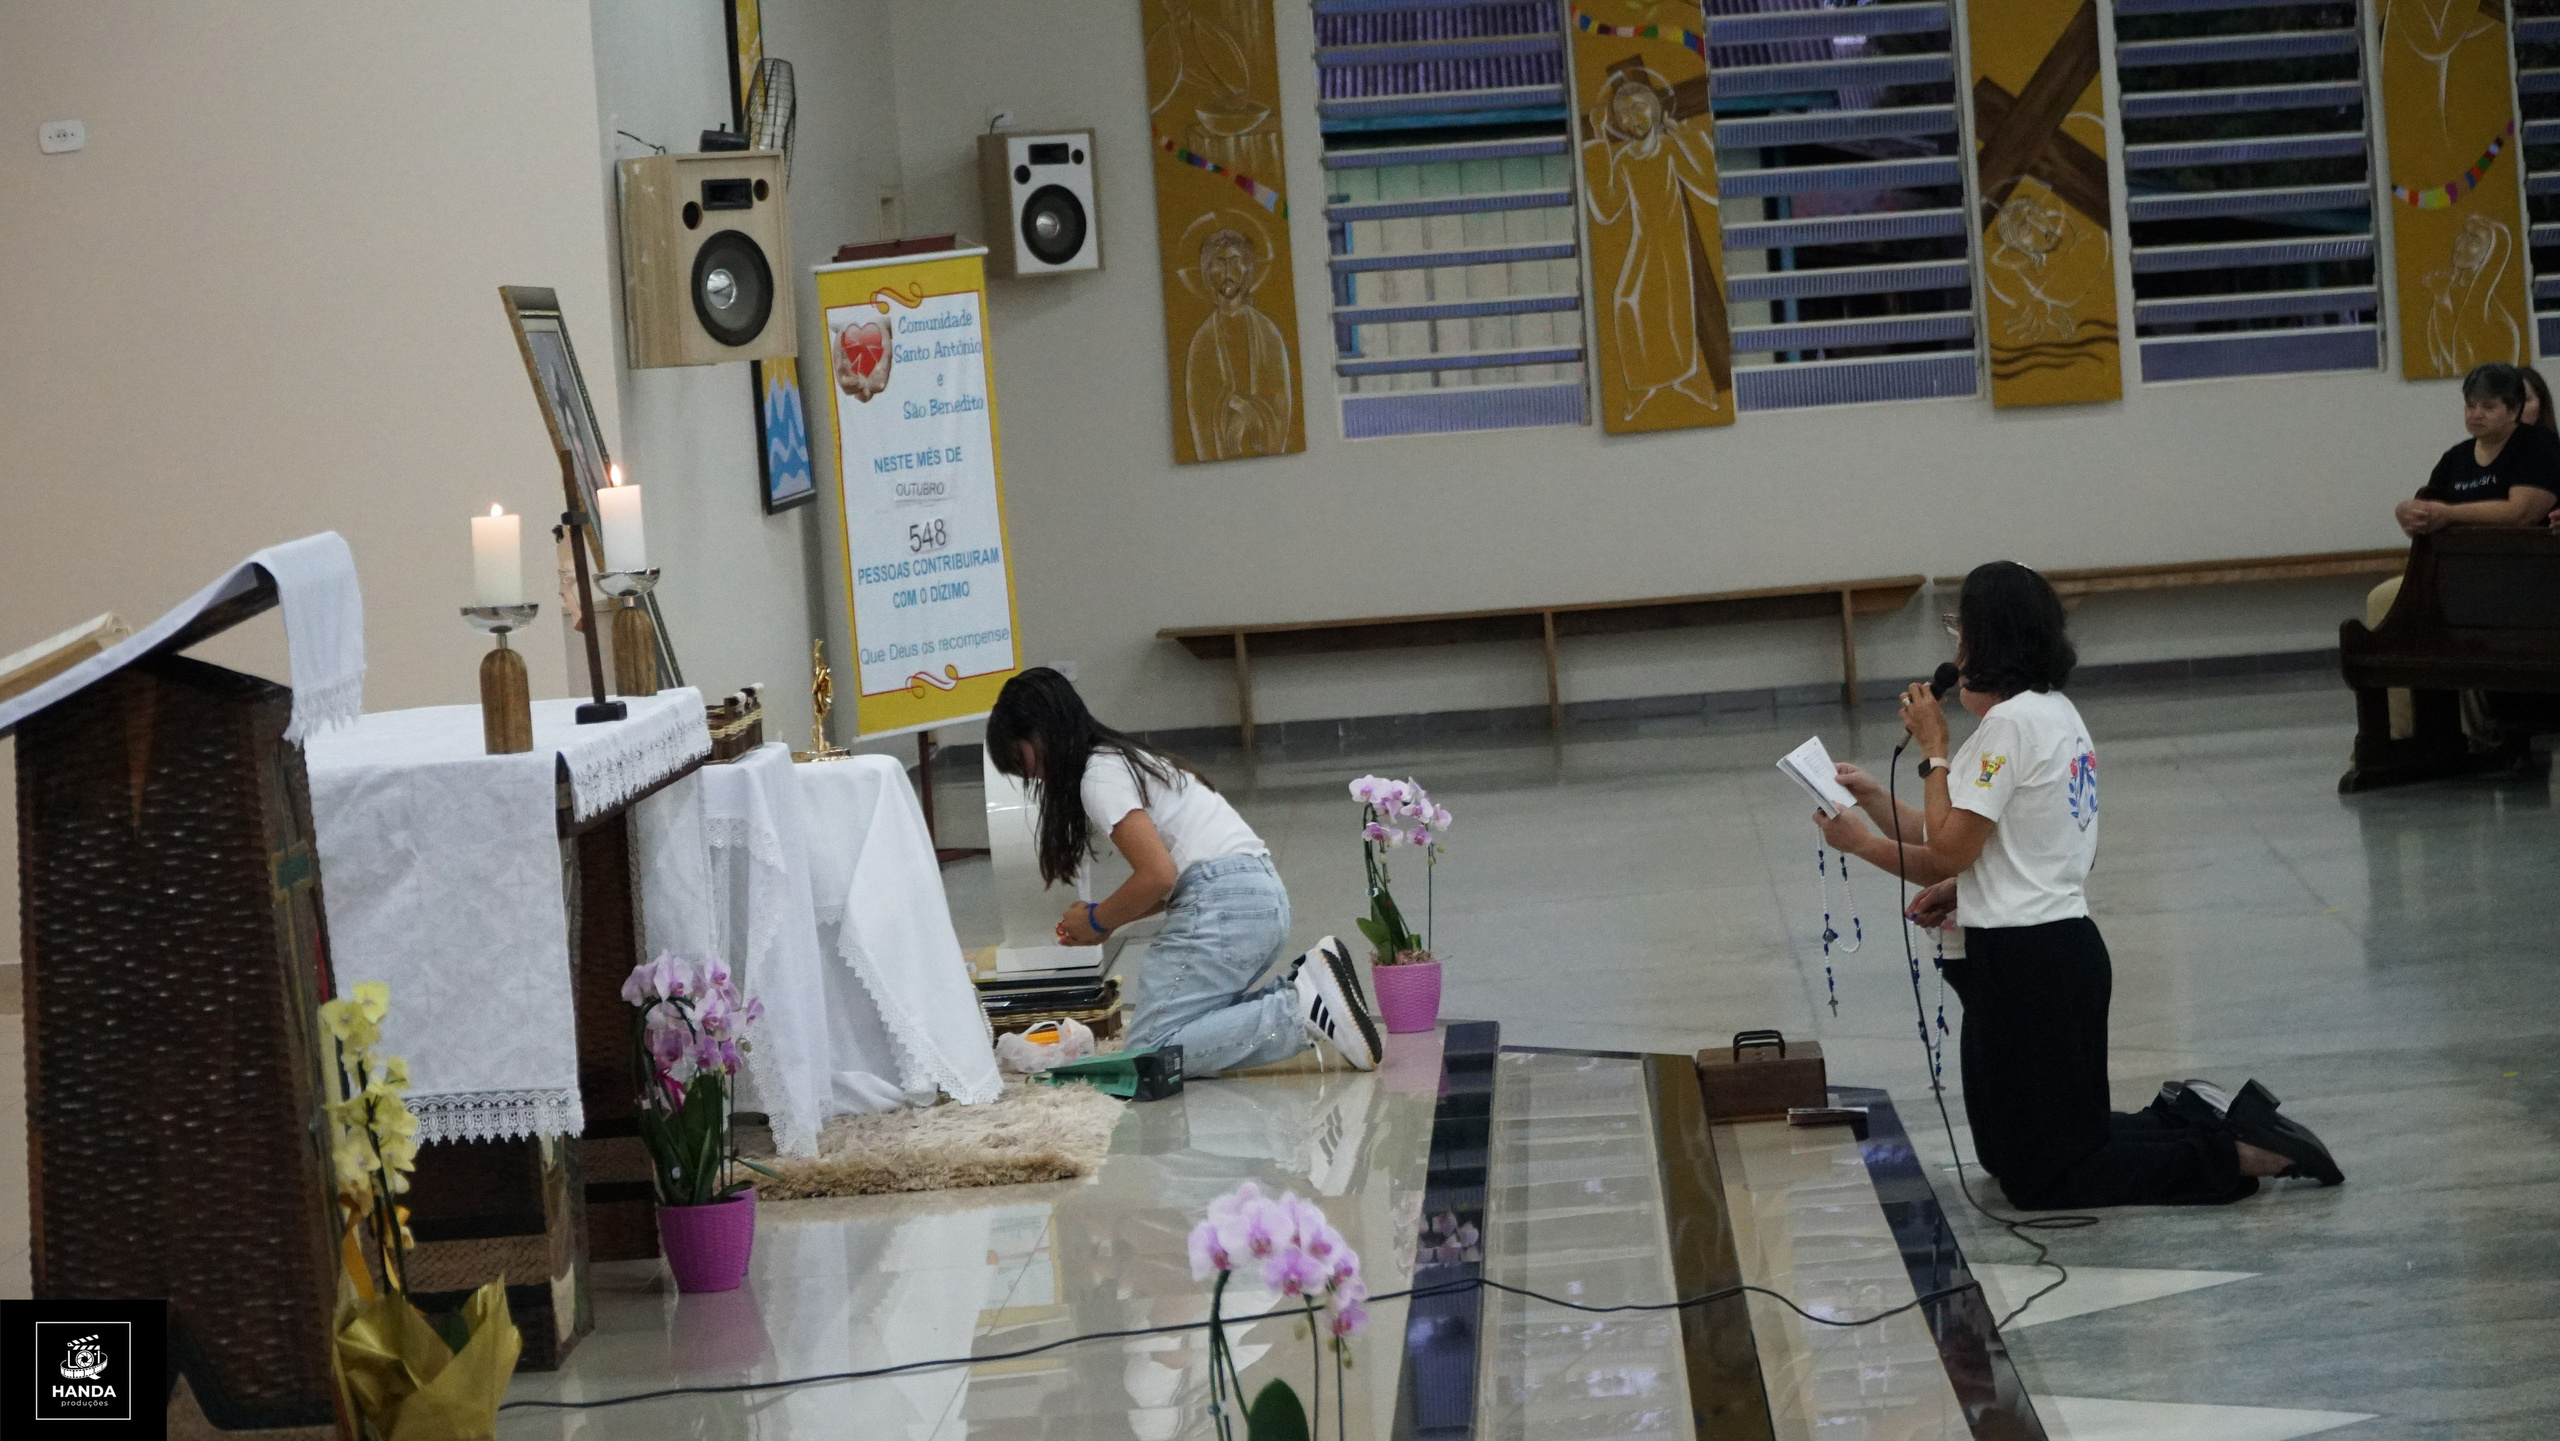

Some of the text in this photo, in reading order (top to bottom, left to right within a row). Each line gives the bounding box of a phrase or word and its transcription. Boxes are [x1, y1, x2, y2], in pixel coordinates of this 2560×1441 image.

[899, 309, 972, 334] Comunidade
[894, 344, 930, 363] Santo
[937, 373, 944, 387] e
[930, 394, 983, 416] Benedito
[874, 446, 963, 474] NESTE MÊS DE
[896, 482, 944, 496] OUTUBRO
[909, 518, 947, 553] 548
[858, 547, 1000, 585] PESSOAS CONTRIBUIRAM
[893, 581, 970, 609] COM O DÍZIMO
[860, 628, 1009, 665] Que Deus os recompense
